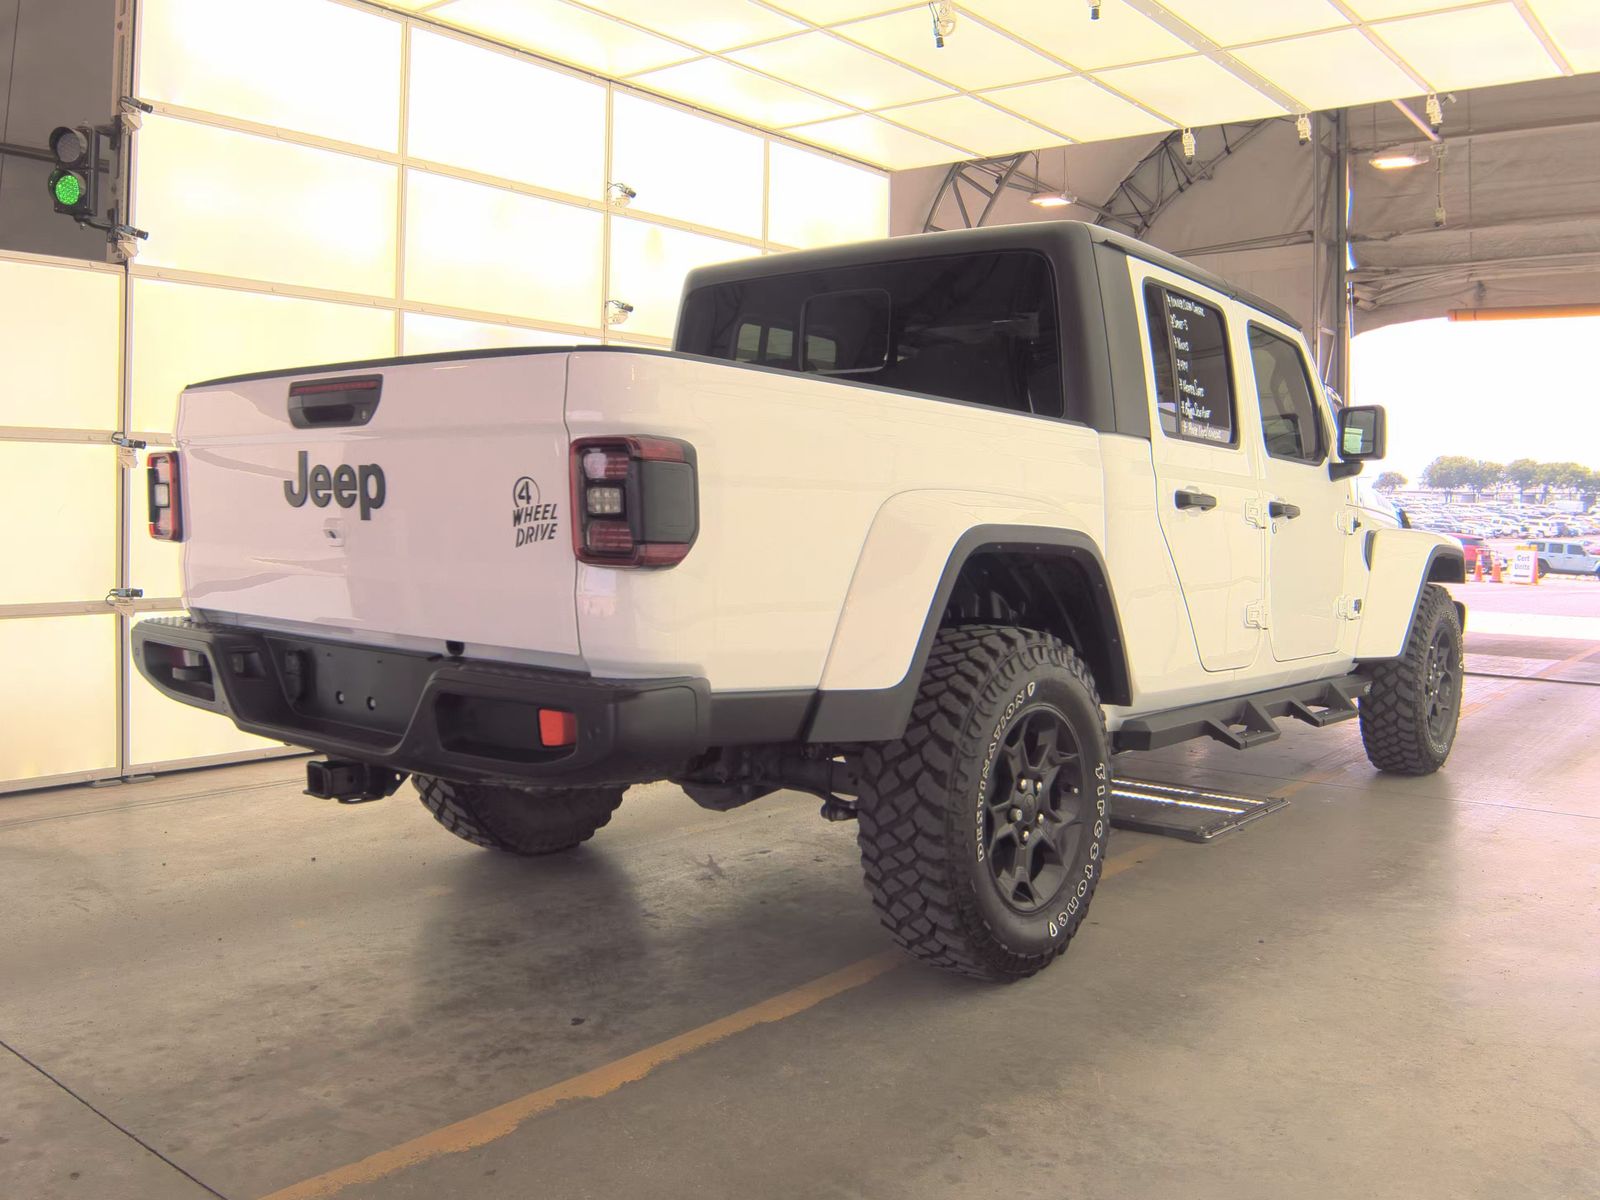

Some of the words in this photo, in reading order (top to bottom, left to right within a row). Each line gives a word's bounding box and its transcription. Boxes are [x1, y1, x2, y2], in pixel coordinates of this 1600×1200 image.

[283, 451, 386, 521] Jeep
[515, 479, 534, 505] 4
[513, 503, 558, 527] WHEEL
[515, 523, 558, 548] DRIVE
[976, 689, 1026, 863] DESTINATION
